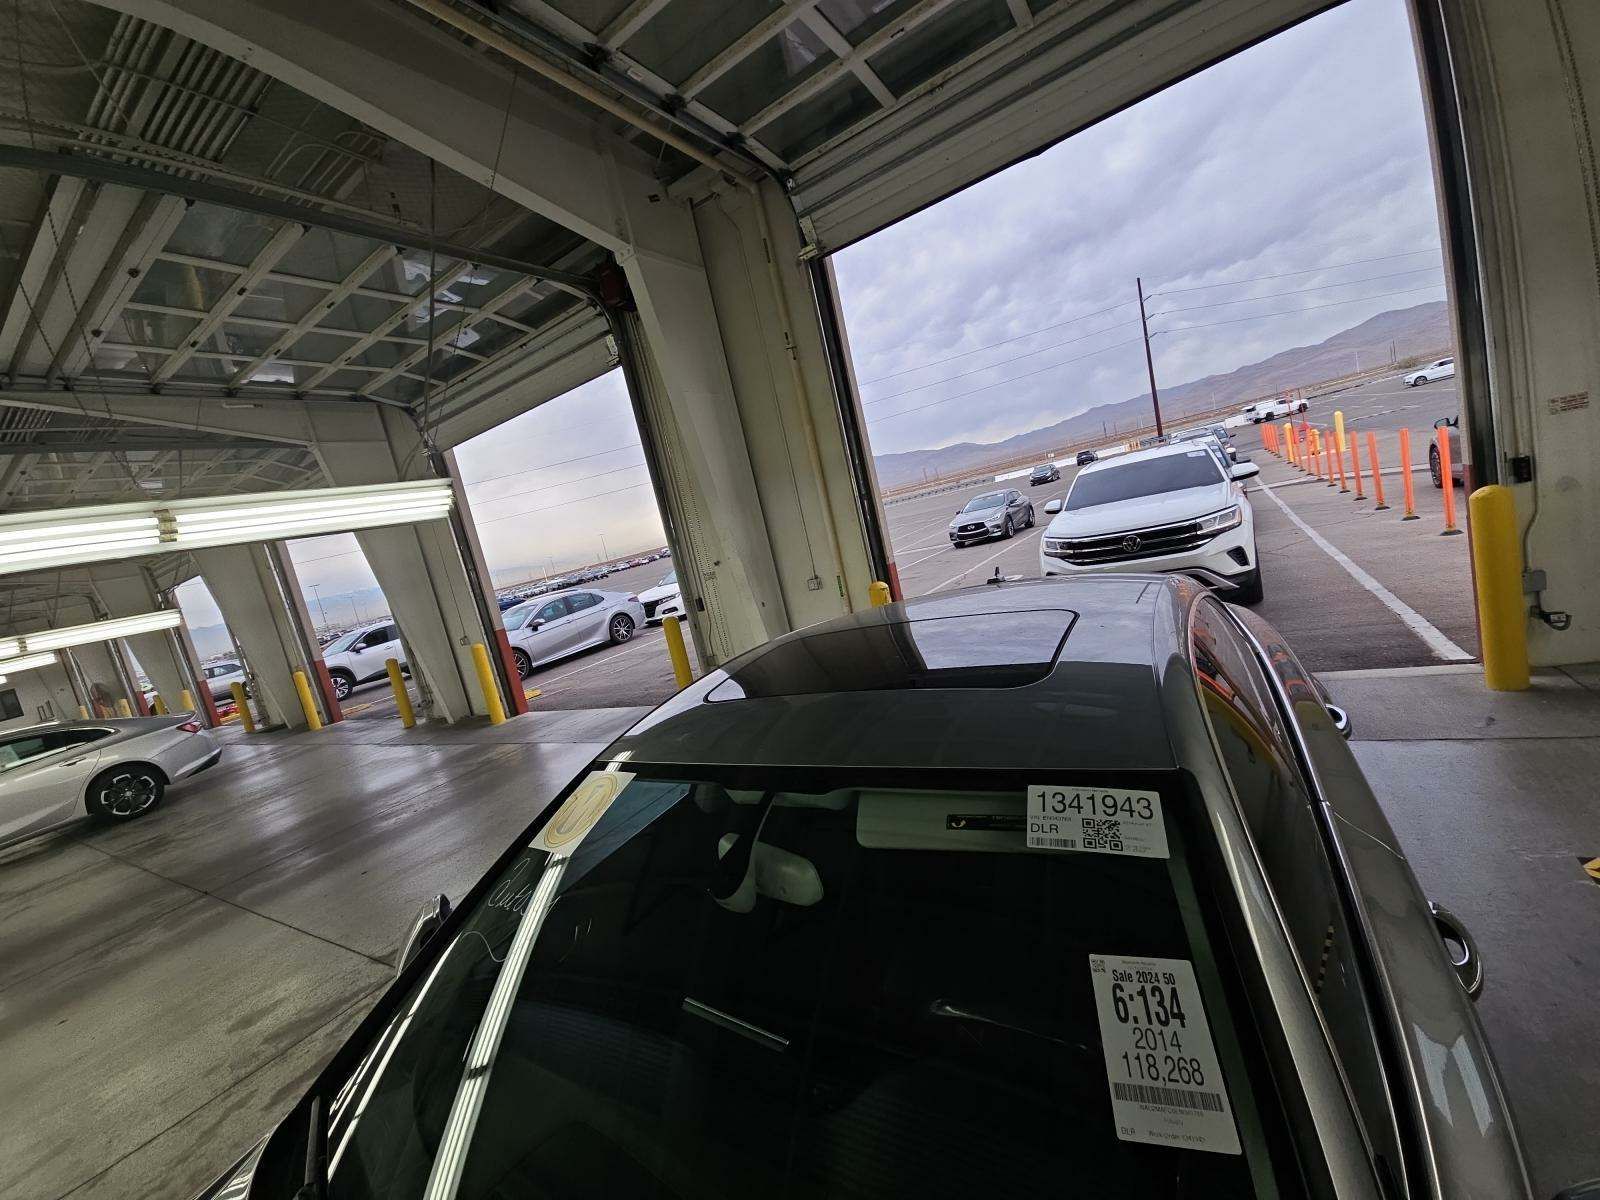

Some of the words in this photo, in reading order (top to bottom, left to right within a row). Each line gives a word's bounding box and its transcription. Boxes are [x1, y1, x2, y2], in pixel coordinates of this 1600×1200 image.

[1037, 791, 1154, 820] 1341943
[1030, 823, 1059, 834] DLR
[1112, 969, 1133, 983] Sale
[1136, 970, 1160, 985] 2024
[1163, 972, 1176, 986] 50
[1112, 982, 1186, 1029] 6:134
[1132, 1027, 1182, 1054] 2014
[1122, 1051, 1205, 1087] 118,268
